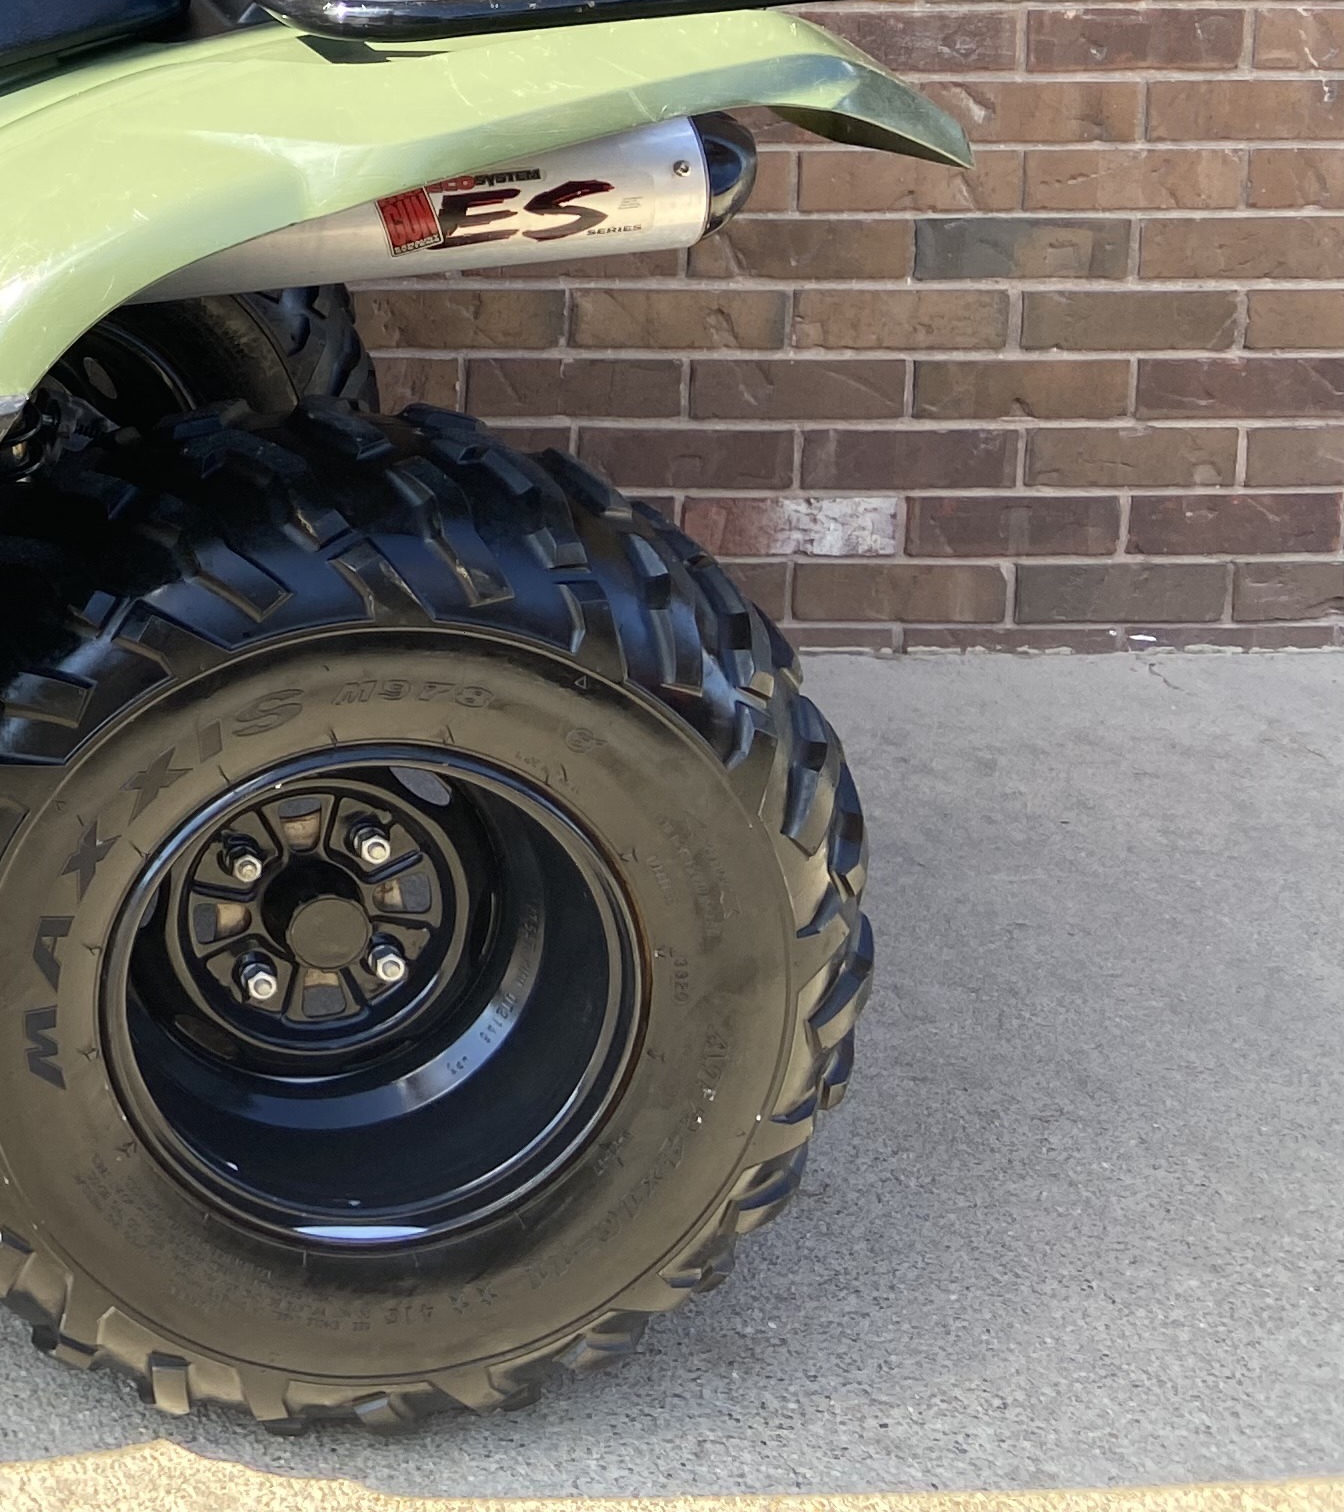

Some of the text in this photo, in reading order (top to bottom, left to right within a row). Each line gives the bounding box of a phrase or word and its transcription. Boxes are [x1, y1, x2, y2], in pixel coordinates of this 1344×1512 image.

[427, 178, 615, 251] ES
[586, 224, 642, 236] SERIES
[22, 677, 495, 1092] MAXXIS M978
